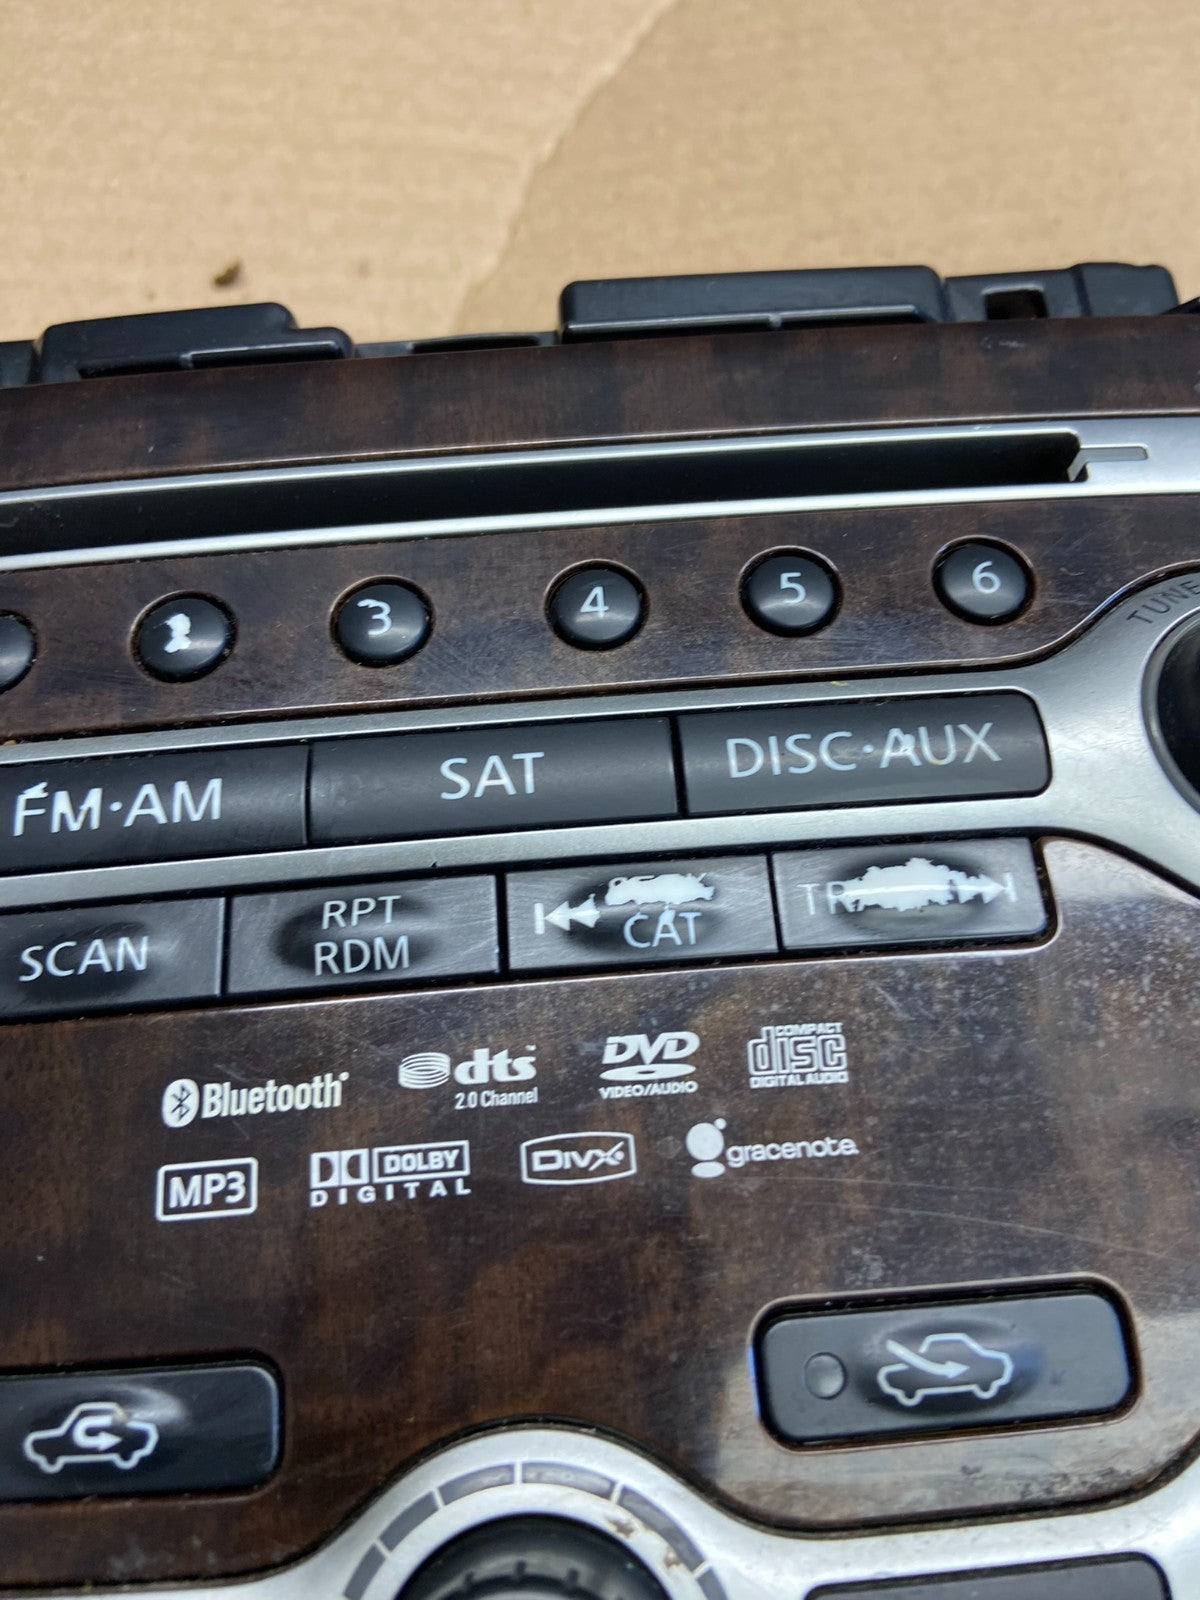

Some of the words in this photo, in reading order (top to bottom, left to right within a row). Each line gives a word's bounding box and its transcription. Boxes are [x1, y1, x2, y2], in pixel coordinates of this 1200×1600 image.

[779, 572, 806, 604] 5
[971, 561, 1000, 594] 6
[358, 599, 391, 635] 3
[580, 586, 608, 618] 4
[1126, 580, 1200, 623] TUNE
[439, 752, 545, 800] SAT
[322, 896, 401, 930] RPT
[623, 911, 702, 948] CAT
[19, 936, 149, 982] SCAN
[314, 936, 410, 976] RDM
[775, 1022, 843, 1037] COMPACT
[602, 1031, 699, 1065] DVD
[454, 1048, 537, 1085] dts
[750, 1074, 804, 1089] DIGITAL
[805, 1071, 849, 1085] AUDIO
[201, 1072, 343, 1119] Bluetooth
[454, 1091, 478, 1110] 2.0
[480, 1086, 539, 1107] Channel
[599, 1080, 699, 1100] VIDEO/AUDIO
[383, 1149, 460, 1175] DOLBY
[169, 1170, 247, 1209] MP3
[310, 1178, 472, 1208] DIGITAL
